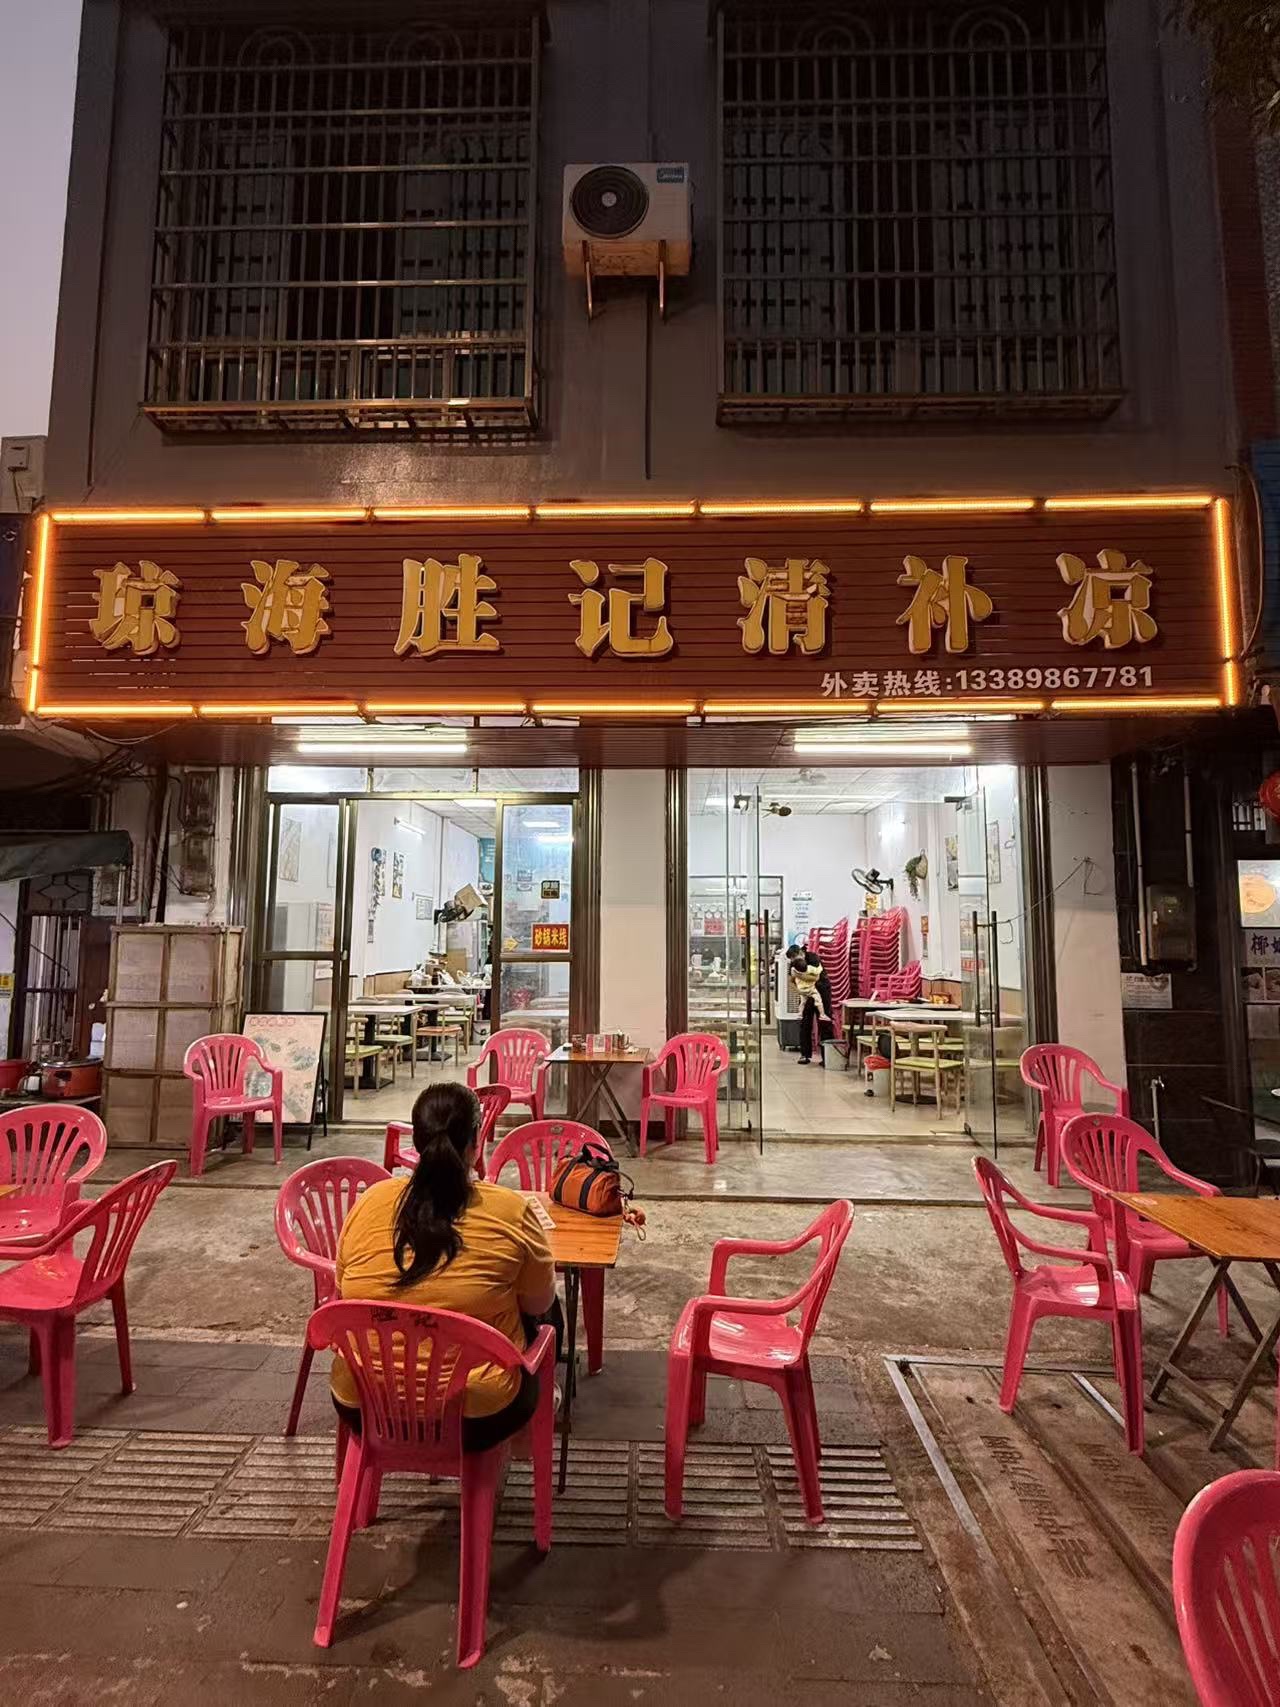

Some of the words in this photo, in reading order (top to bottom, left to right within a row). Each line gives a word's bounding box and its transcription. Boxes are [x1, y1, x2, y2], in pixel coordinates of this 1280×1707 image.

[90, 549, 1158, 658] 琼海胜记清补凉
[820, 665, 1153, 698] 外卖热线:13389867781
[534, 927, 567, 946] 砂锅米线
